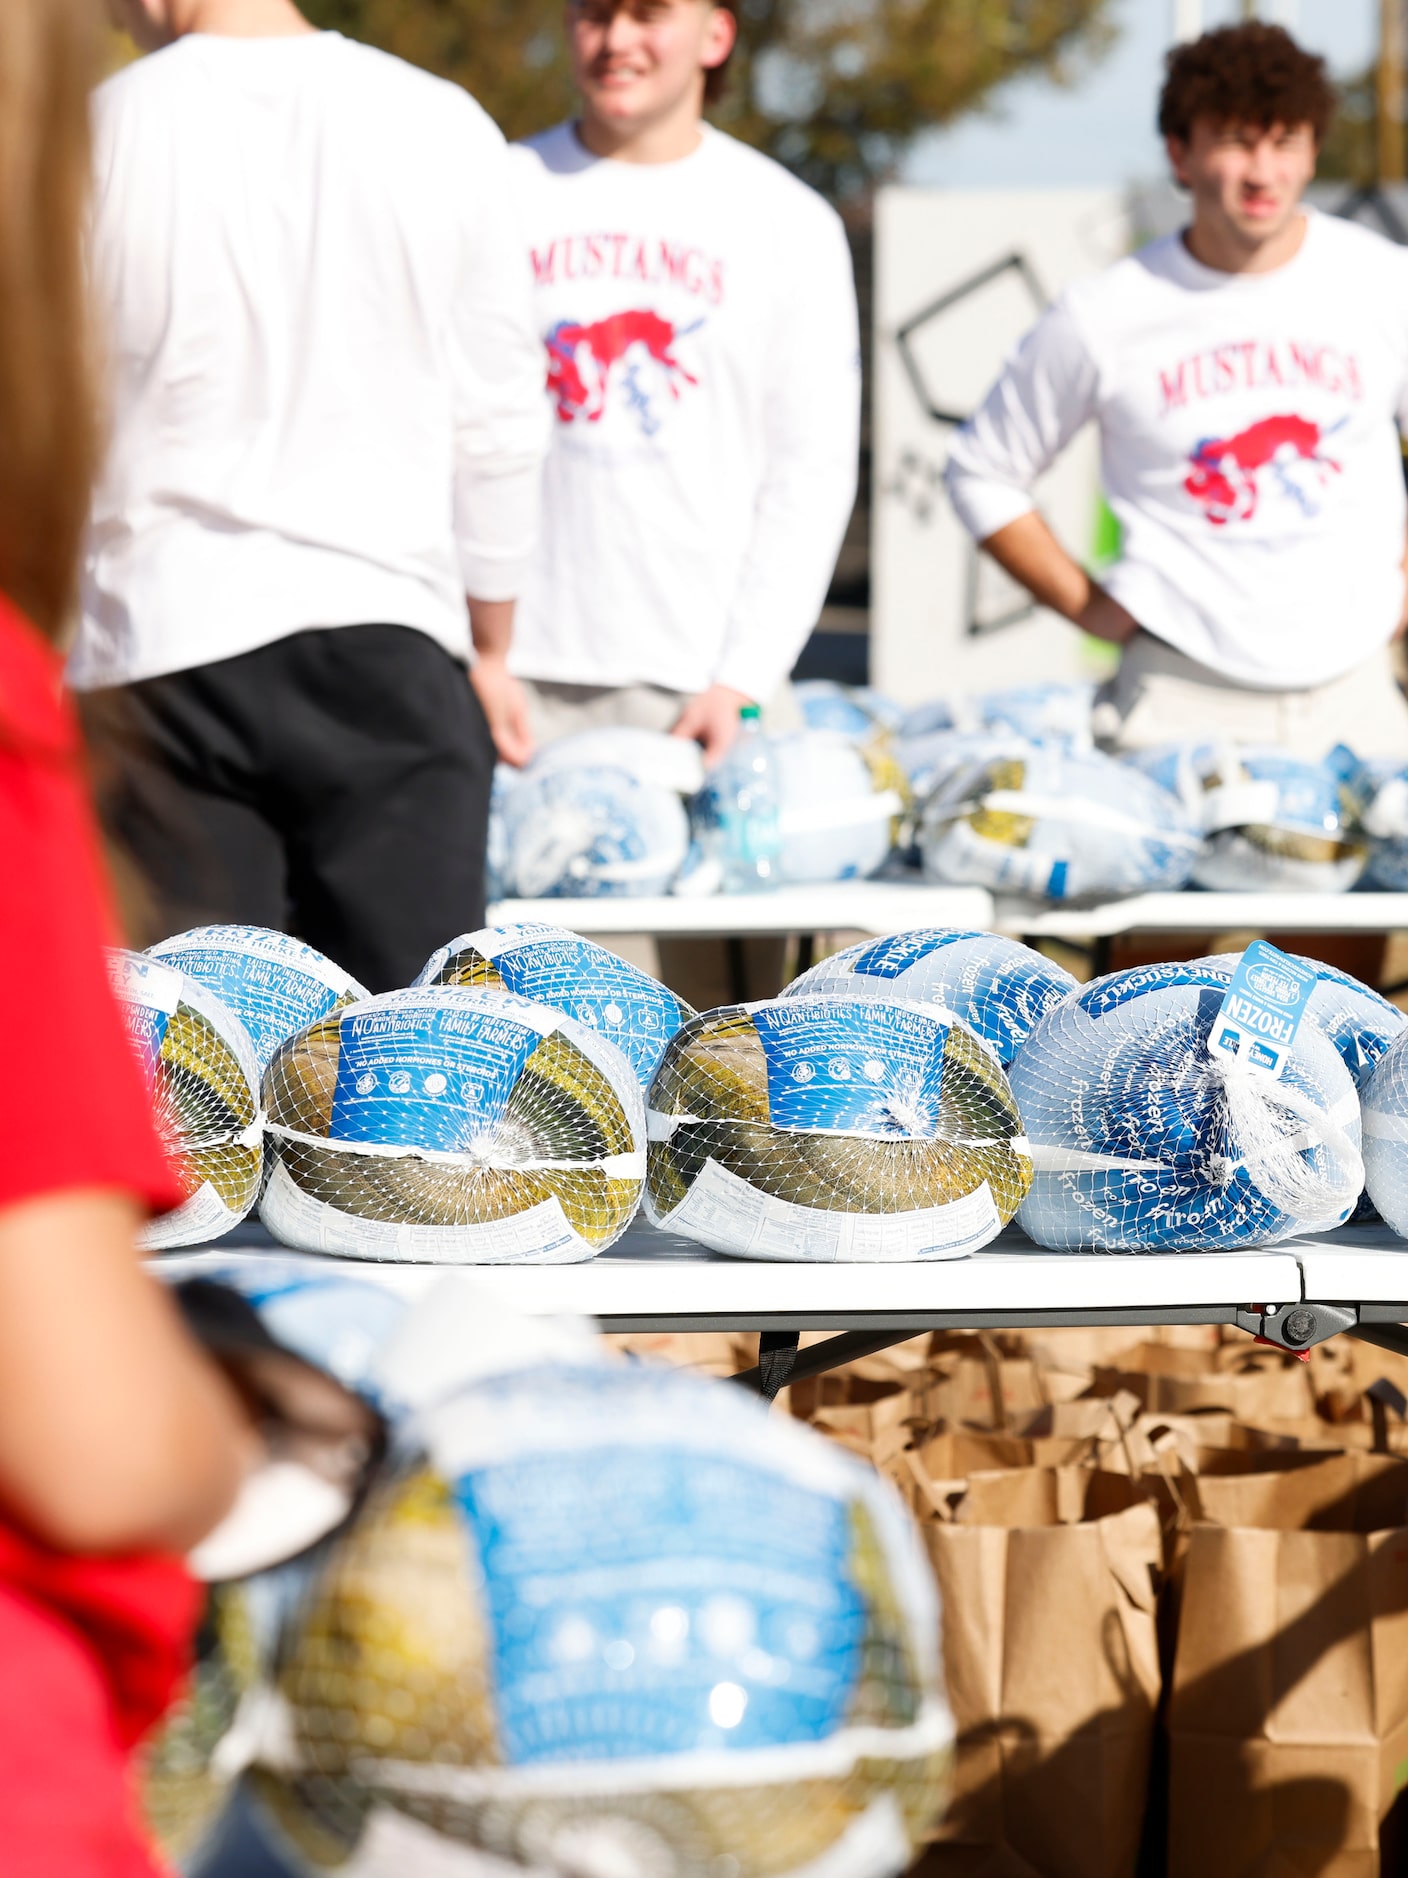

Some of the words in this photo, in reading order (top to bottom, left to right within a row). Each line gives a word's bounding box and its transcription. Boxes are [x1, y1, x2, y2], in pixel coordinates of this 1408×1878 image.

[1158, 339, 1365, 418] MUSTANGS
[505, 953, 529, 973] NO
[961, 955, 990, 994] frozen
[1000, 955, 1039, 976] frozen
[242, 965, 276, 987] FAMILY
[278, 977, 322, 1007] FARMERS
[1094, 965, 1231, 1008] ONEYSUCKLE
[351, 1018, 374, 1038] NO
[373, 1019, 432, 1033] ANTIBIOTICS
[439, 1016, 475, 1036] FAMILY
[476, 1023, 526, 1051] FARMERS
[441, 1009, 469, 1020] RAISED
[471, 1014, 481, 1023] BY
[481, 1014, 533, 1037] INDEPENDENT
[765, 1009, 791, 1030] NO
[790, 1008, 852, 1024] ANTIBIOTICS
[860, 1008, 895, 1028] FAMILY
[895, 1017, 938, 1040] FARMERS
[1226, 994, 1294, 1044] FROZEN
[368, 1057, 394, 1066] ADDED
[395, 1056, 442, 1067] HORMONES
[443, 1060, 456, 1068] OR
[801, 1046, 828, 1055] ADDED
[1071, 1080, 1092, 1149] frozen
[1057, 1171, 1119, 1228] frozen
